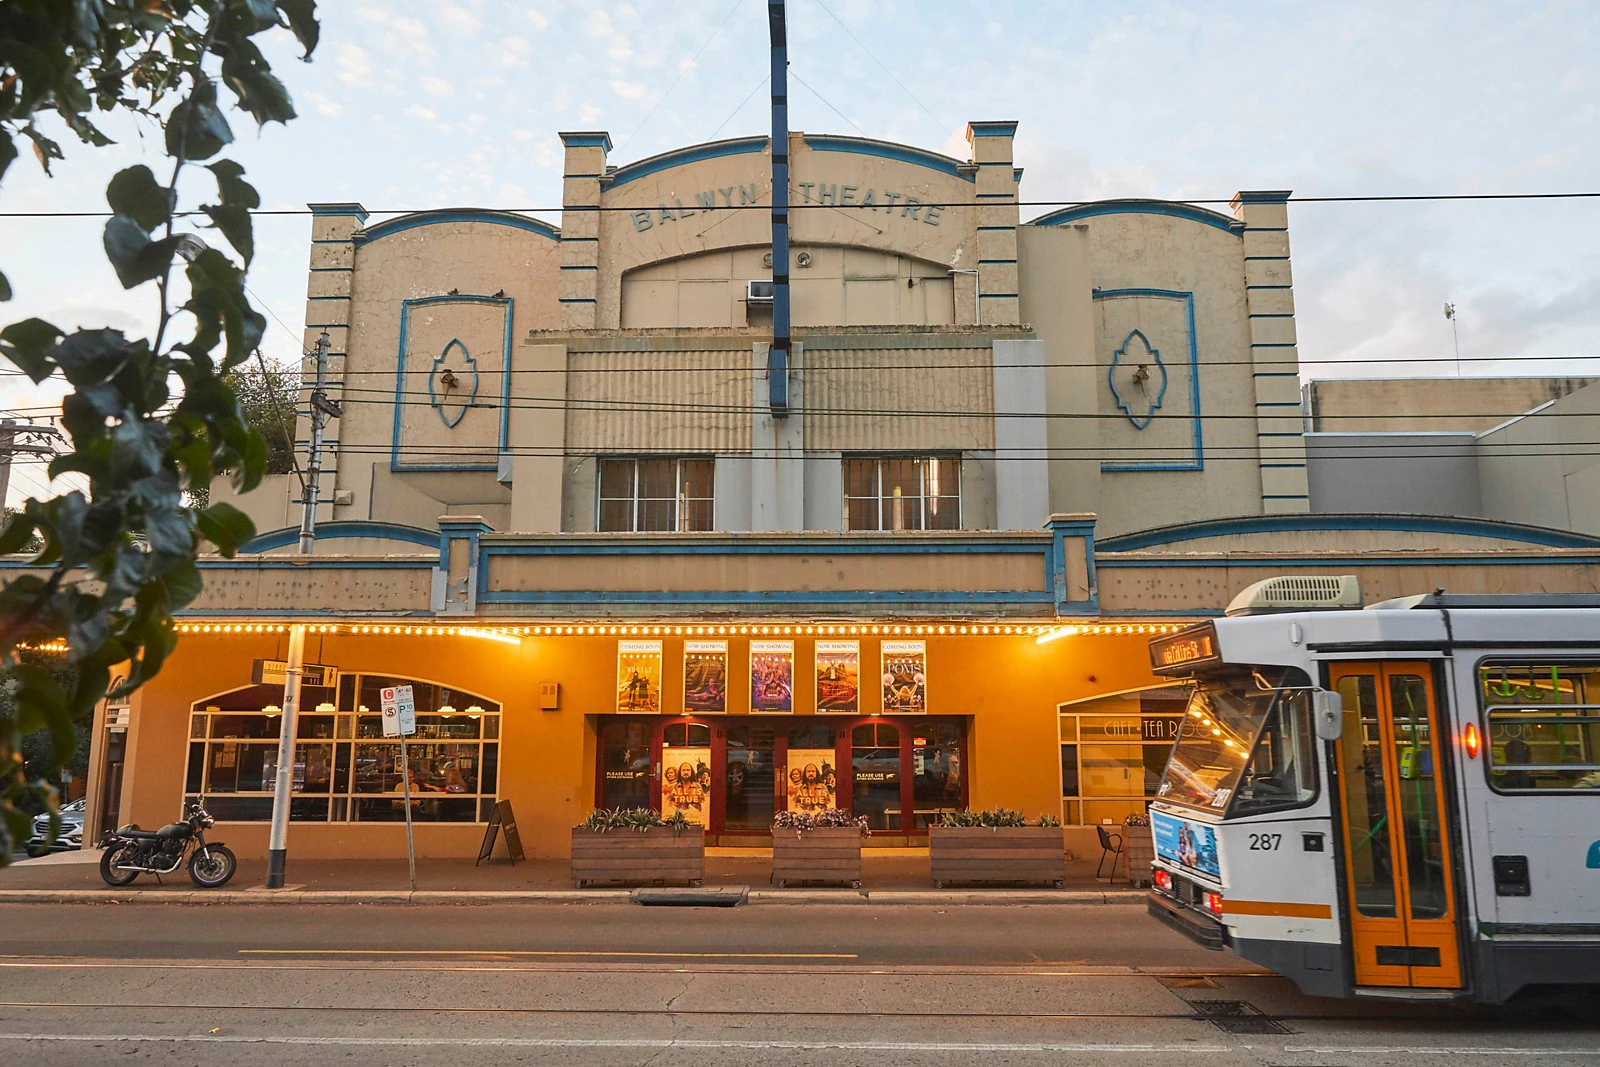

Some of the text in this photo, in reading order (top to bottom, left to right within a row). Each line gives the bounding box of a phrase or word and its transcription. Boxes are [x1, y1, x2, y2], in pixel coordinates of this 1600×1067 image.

[630, 181, 946, 233] BALWYN THEATRE
[887, 662, 922, 675] POMS
[399, 705, 406, 713] P
[1143, 720, 1164, 738] TEA
[671, 788, 702, 796] ALL IS
[796, 789, 827, 797] ALL IS
[1249, 833, 1282, 851] 287
